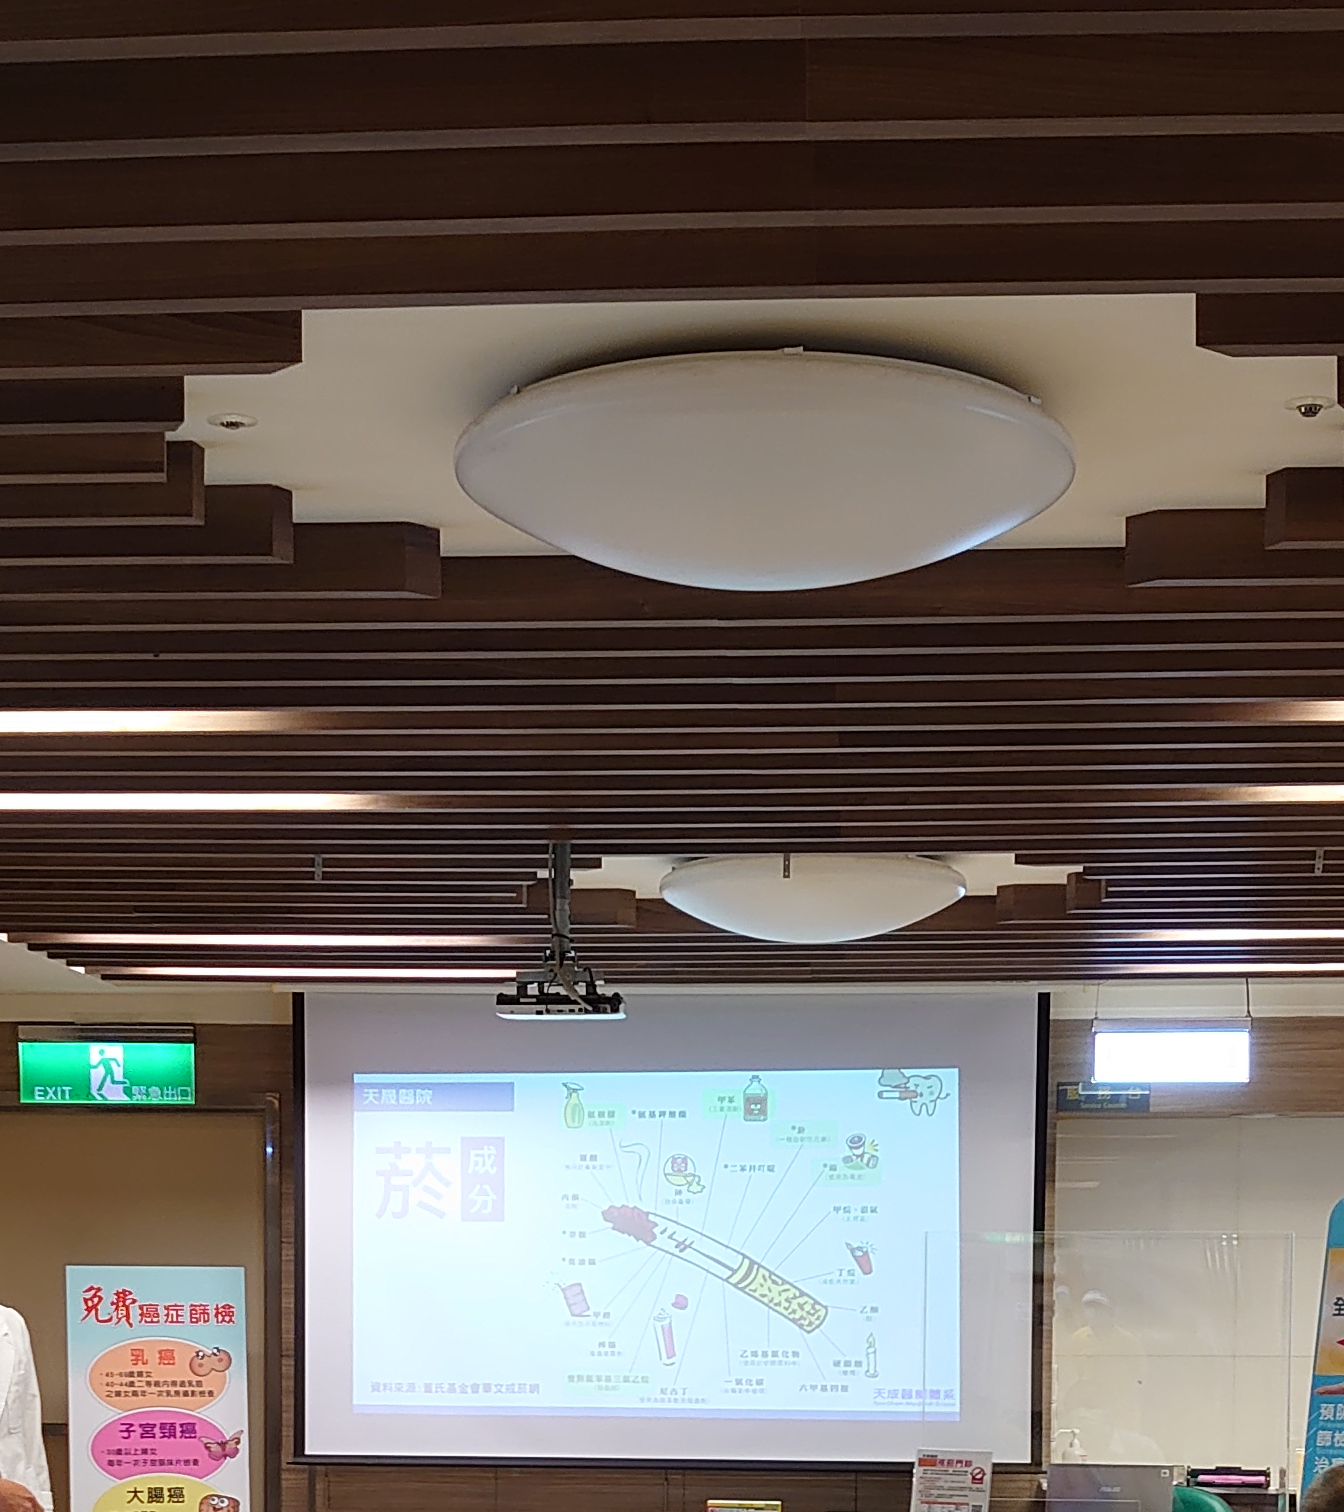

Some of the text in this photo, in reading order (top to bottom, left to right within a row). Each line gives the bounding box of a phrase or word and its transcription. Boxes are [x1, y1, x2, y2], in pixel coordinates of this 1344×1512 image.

[33, 1086, 73, 1101] EXIT
[131, 1085, 192, 1101] 緊急出口
[362, 1088, 433, 1105] 天晟醫院
[375, 1140, 452, 1220] 菸
[466, 1145, 497, 1214] 成分
[119, 1422, 198, 1440] 子宮頸癌
[126, 1487, 186, 1504] 大腸癌
